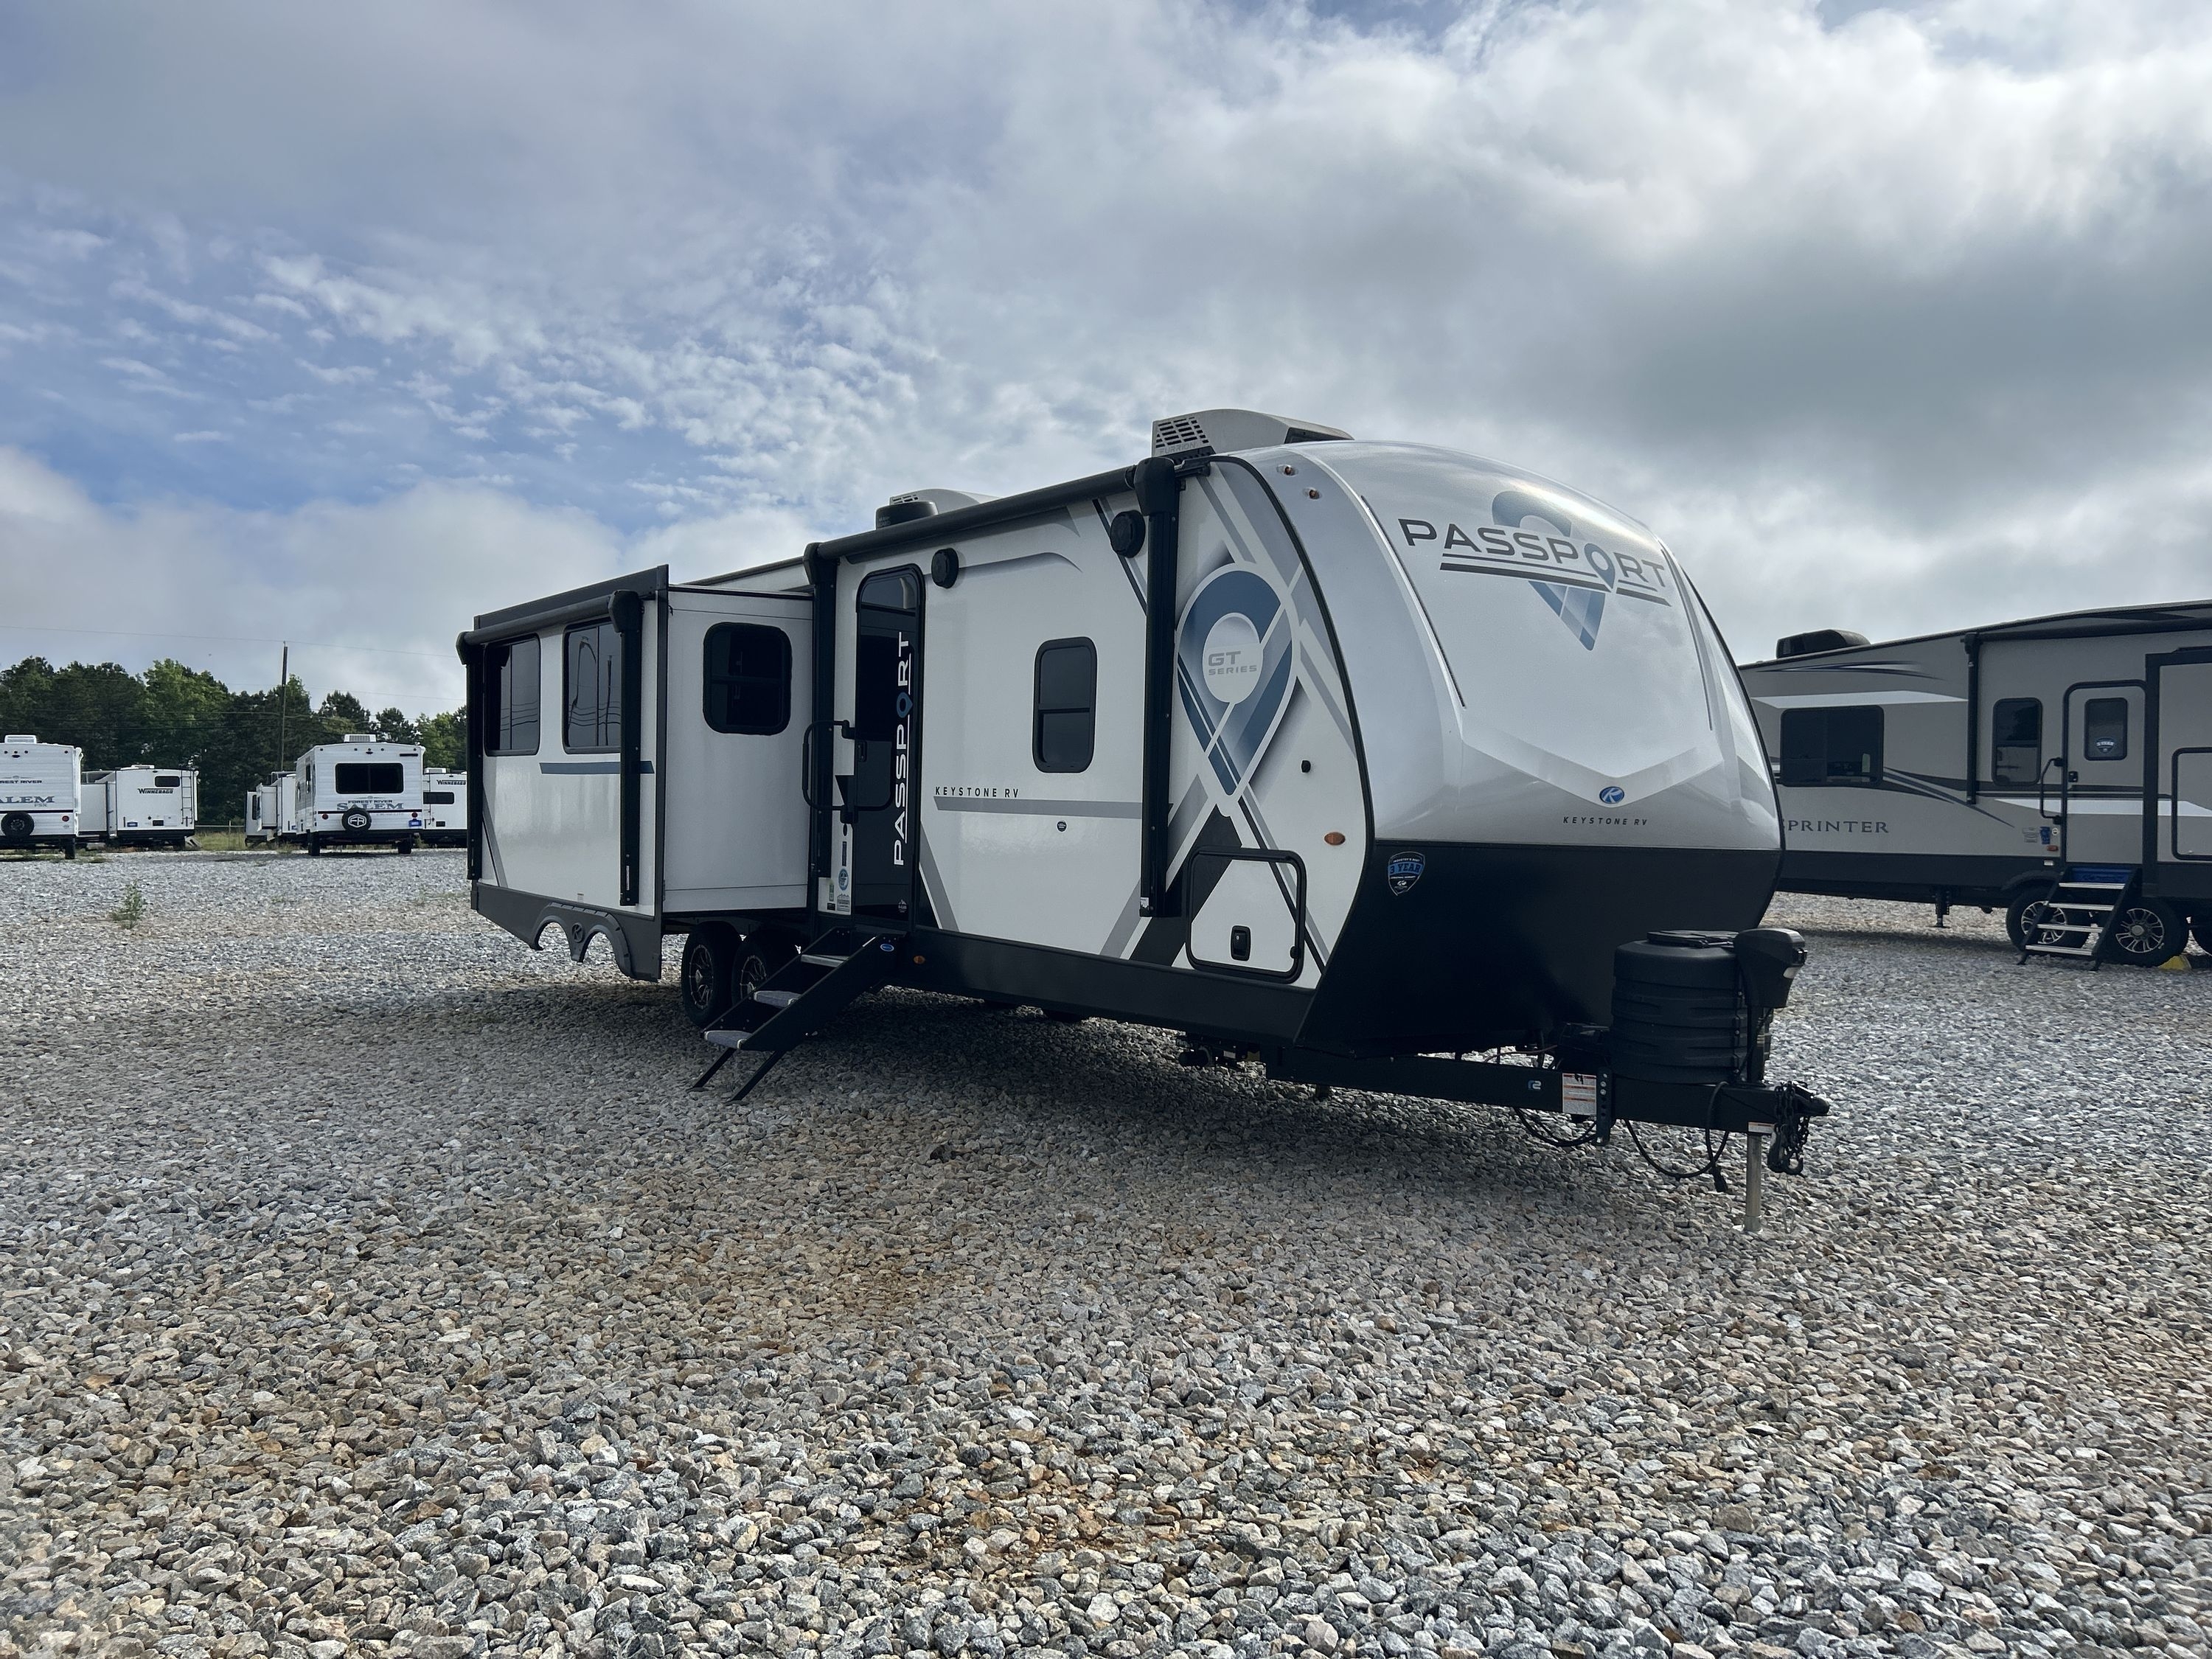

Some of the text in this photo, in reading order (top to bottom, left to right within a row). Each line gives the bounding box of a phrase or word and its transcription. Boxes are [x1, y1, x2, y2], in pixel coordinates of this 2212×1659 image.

[1398, 518, 1666, 589] PASSPORT
[1208, 650, 1241, 667] GT
[1208, 665, 1257, 675] SERIES
[894, 631, 914, 866] PASSPORT
[935, 787, 1019, 798] KEYSTONE RV
[1563, 816, 1628, 825] KEYSTONE
[1783, 818, 1889, 833] PRINTER
[1389, 863, 1422, 874] 3 YEAR
